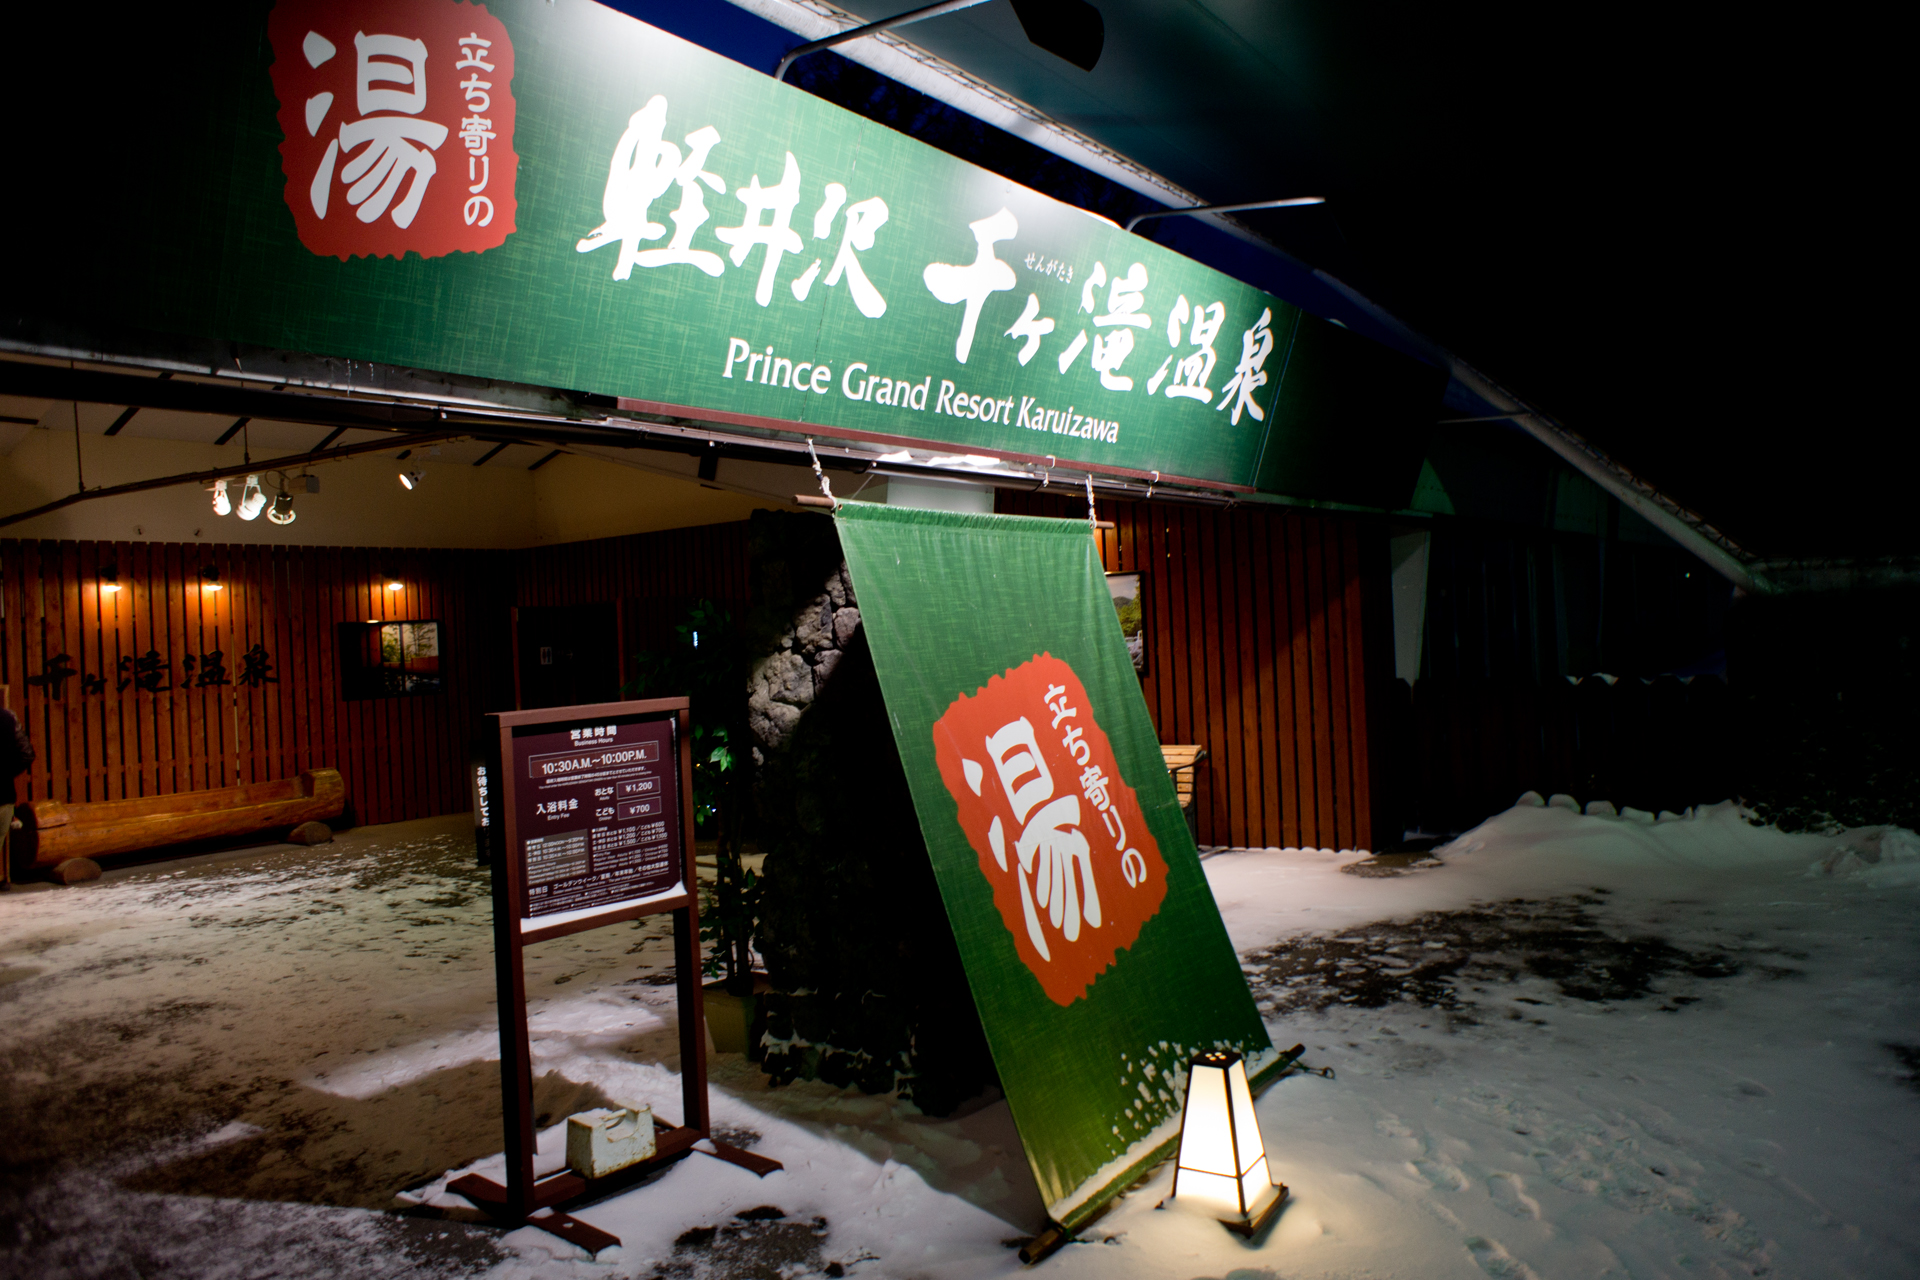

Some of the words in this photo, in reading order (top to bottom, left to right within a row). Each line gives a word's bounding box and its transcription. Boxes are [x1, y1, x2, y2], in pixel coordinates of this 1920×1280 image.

[302, 30, 449, 229] 湯
[455, 31, 497, 227] 立ち寄りの
[576, 95, 890, 317] 軽井沢
[923, 207, 1274, 425] 千ヶ滝温泉
[1023, 251, 1075, 284] せんがたき
[722, 337, 832, 394] Prince
[842, 362, 931, 414] Grand
[936, 379, 1015, 425] Resort
[1016, 396, 1119, 444] Karuizawa
[570, 725, 617, 740] 営業時間
[574, 738, 597, 747] Business
[594, 786, 614, 797] おとな
[625, 781, 653, 793] ¥1,200
[1044, 684, 1147, 888] 立ち寄りの
[536, 798, 579, 815] 入浴料金
[595, 806, 615, 817] こども
[629, 803, 651, 815] ¥700
[962, 716, 1102, 962] 湯
